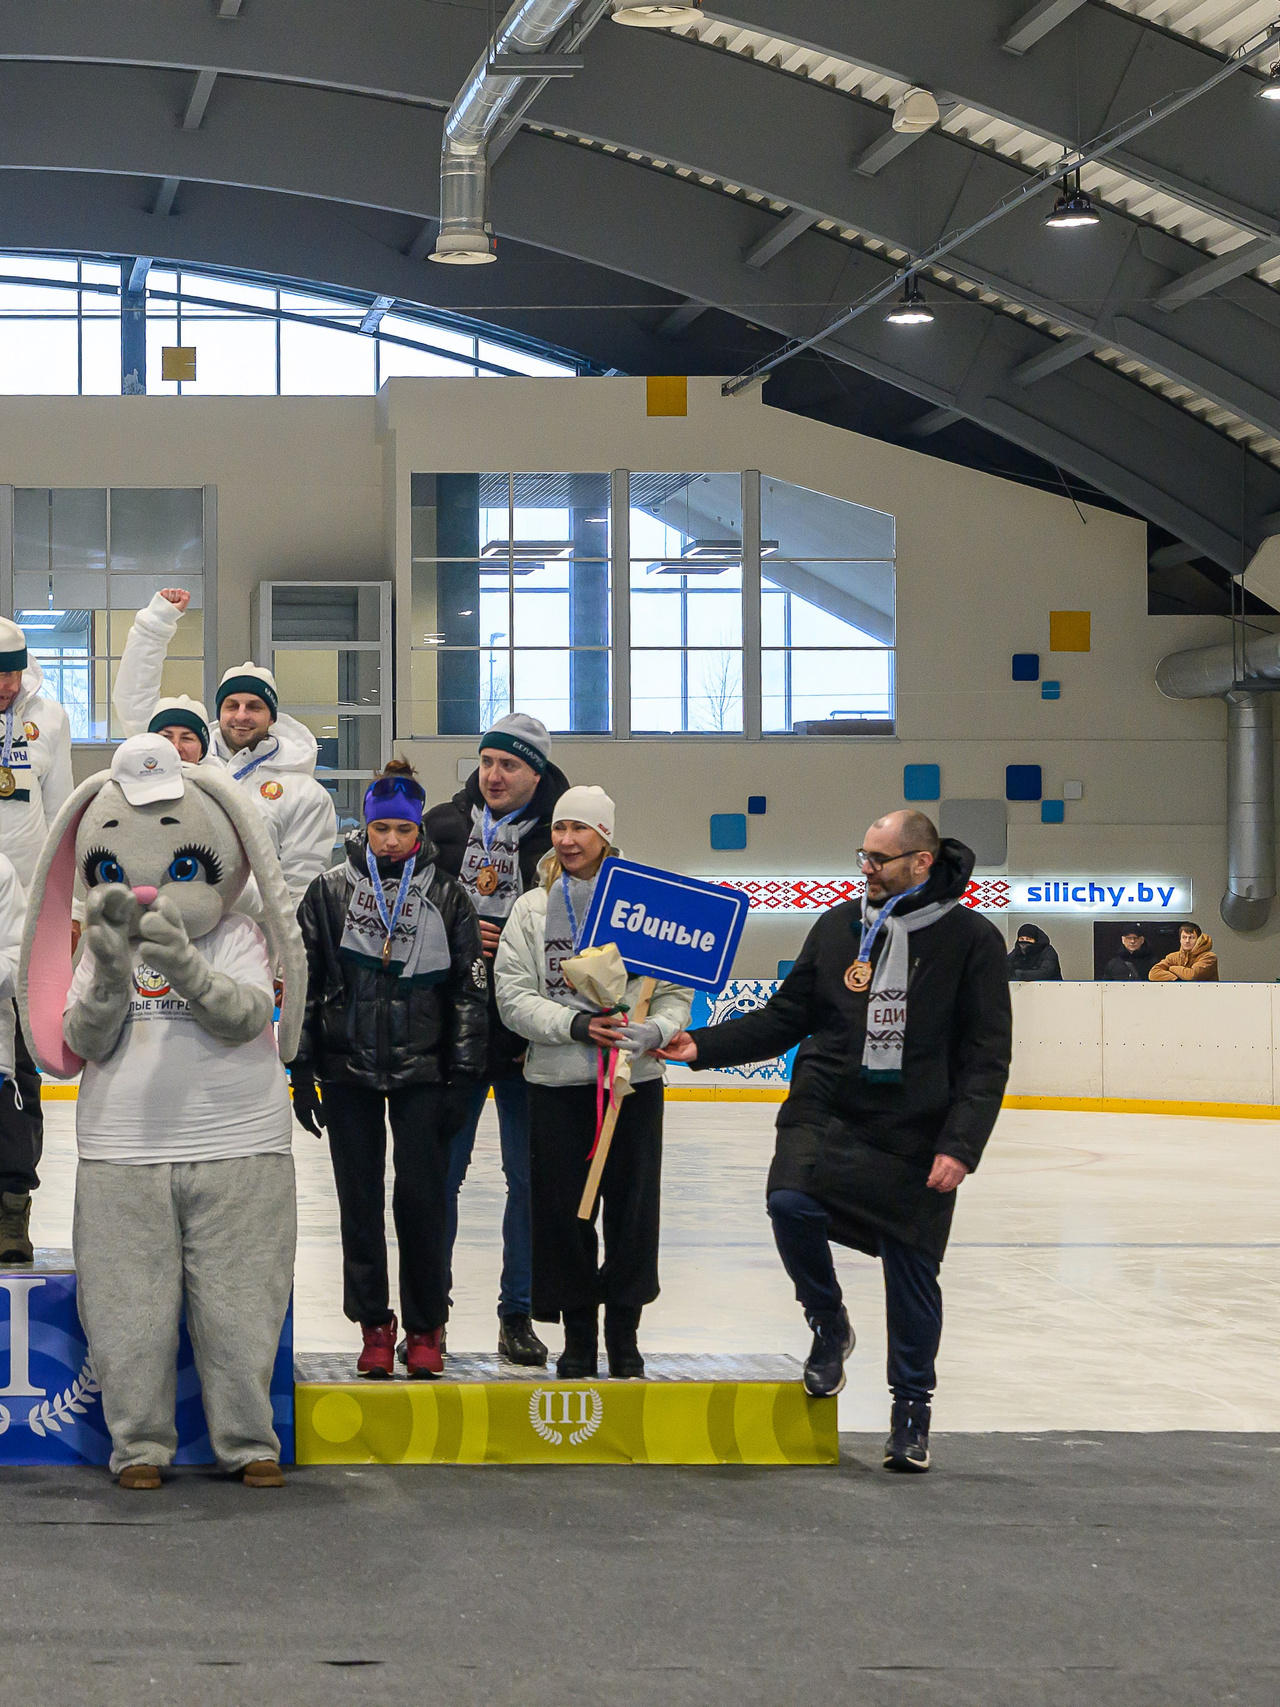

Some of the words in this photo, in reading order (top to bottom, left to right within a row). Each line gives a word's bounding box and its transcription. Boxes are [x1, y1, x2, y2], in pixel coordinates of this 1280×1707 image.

[1027, 881, 1176, 907] silichy.by
[610, 899, 716, 952] Единые
[873, 1008, 905, 1025] ЕДИ
[541, 1391, 591, 1424] III
